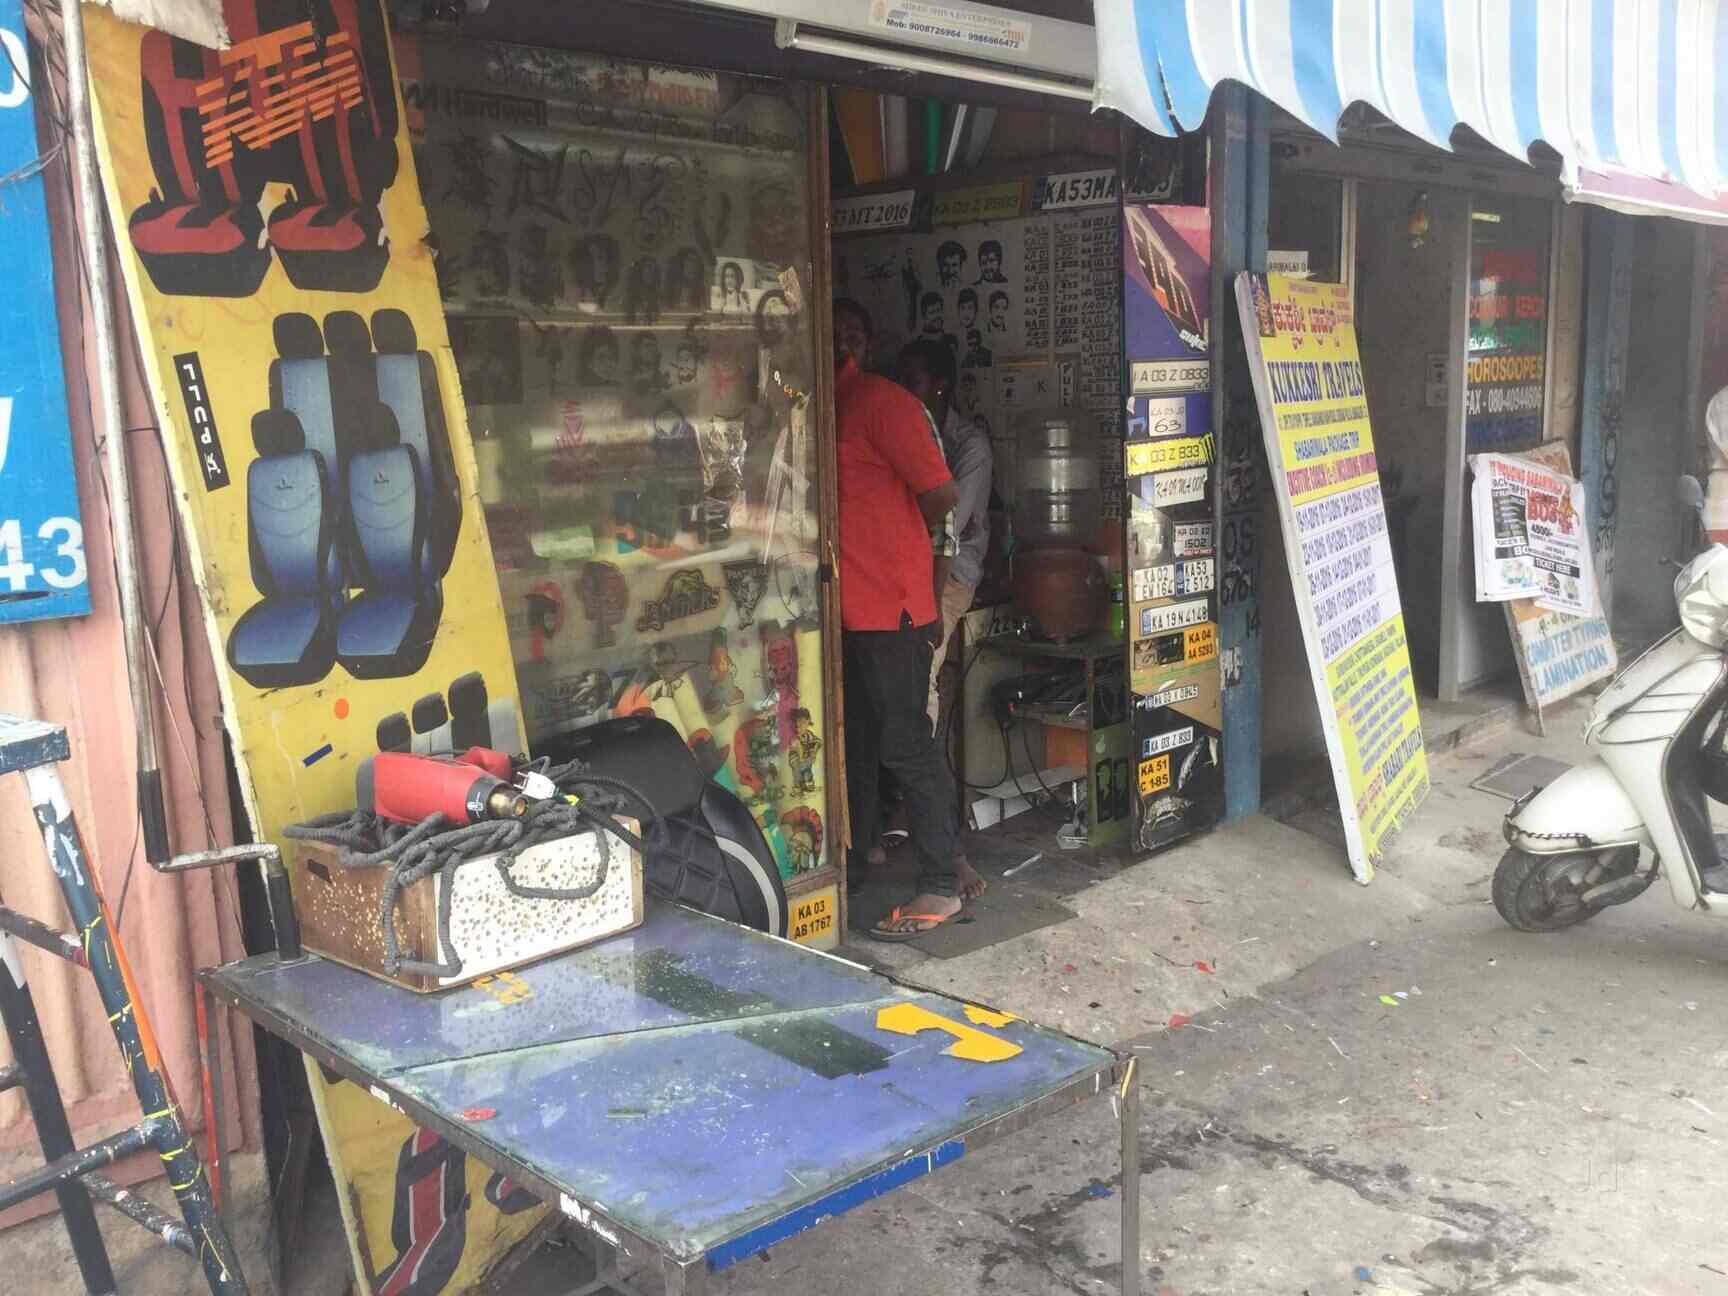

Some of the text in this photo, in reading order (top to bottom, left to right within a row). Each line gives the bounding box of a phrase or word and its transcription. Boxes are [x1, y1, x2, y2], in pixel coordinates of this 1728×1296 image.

[1154, 417, 1182, 433] 63
[1188, 631, 1200, 643] KA
[1141, 759, 1168, 777] KA 51
[798, 900, 825, 920] KA 03
